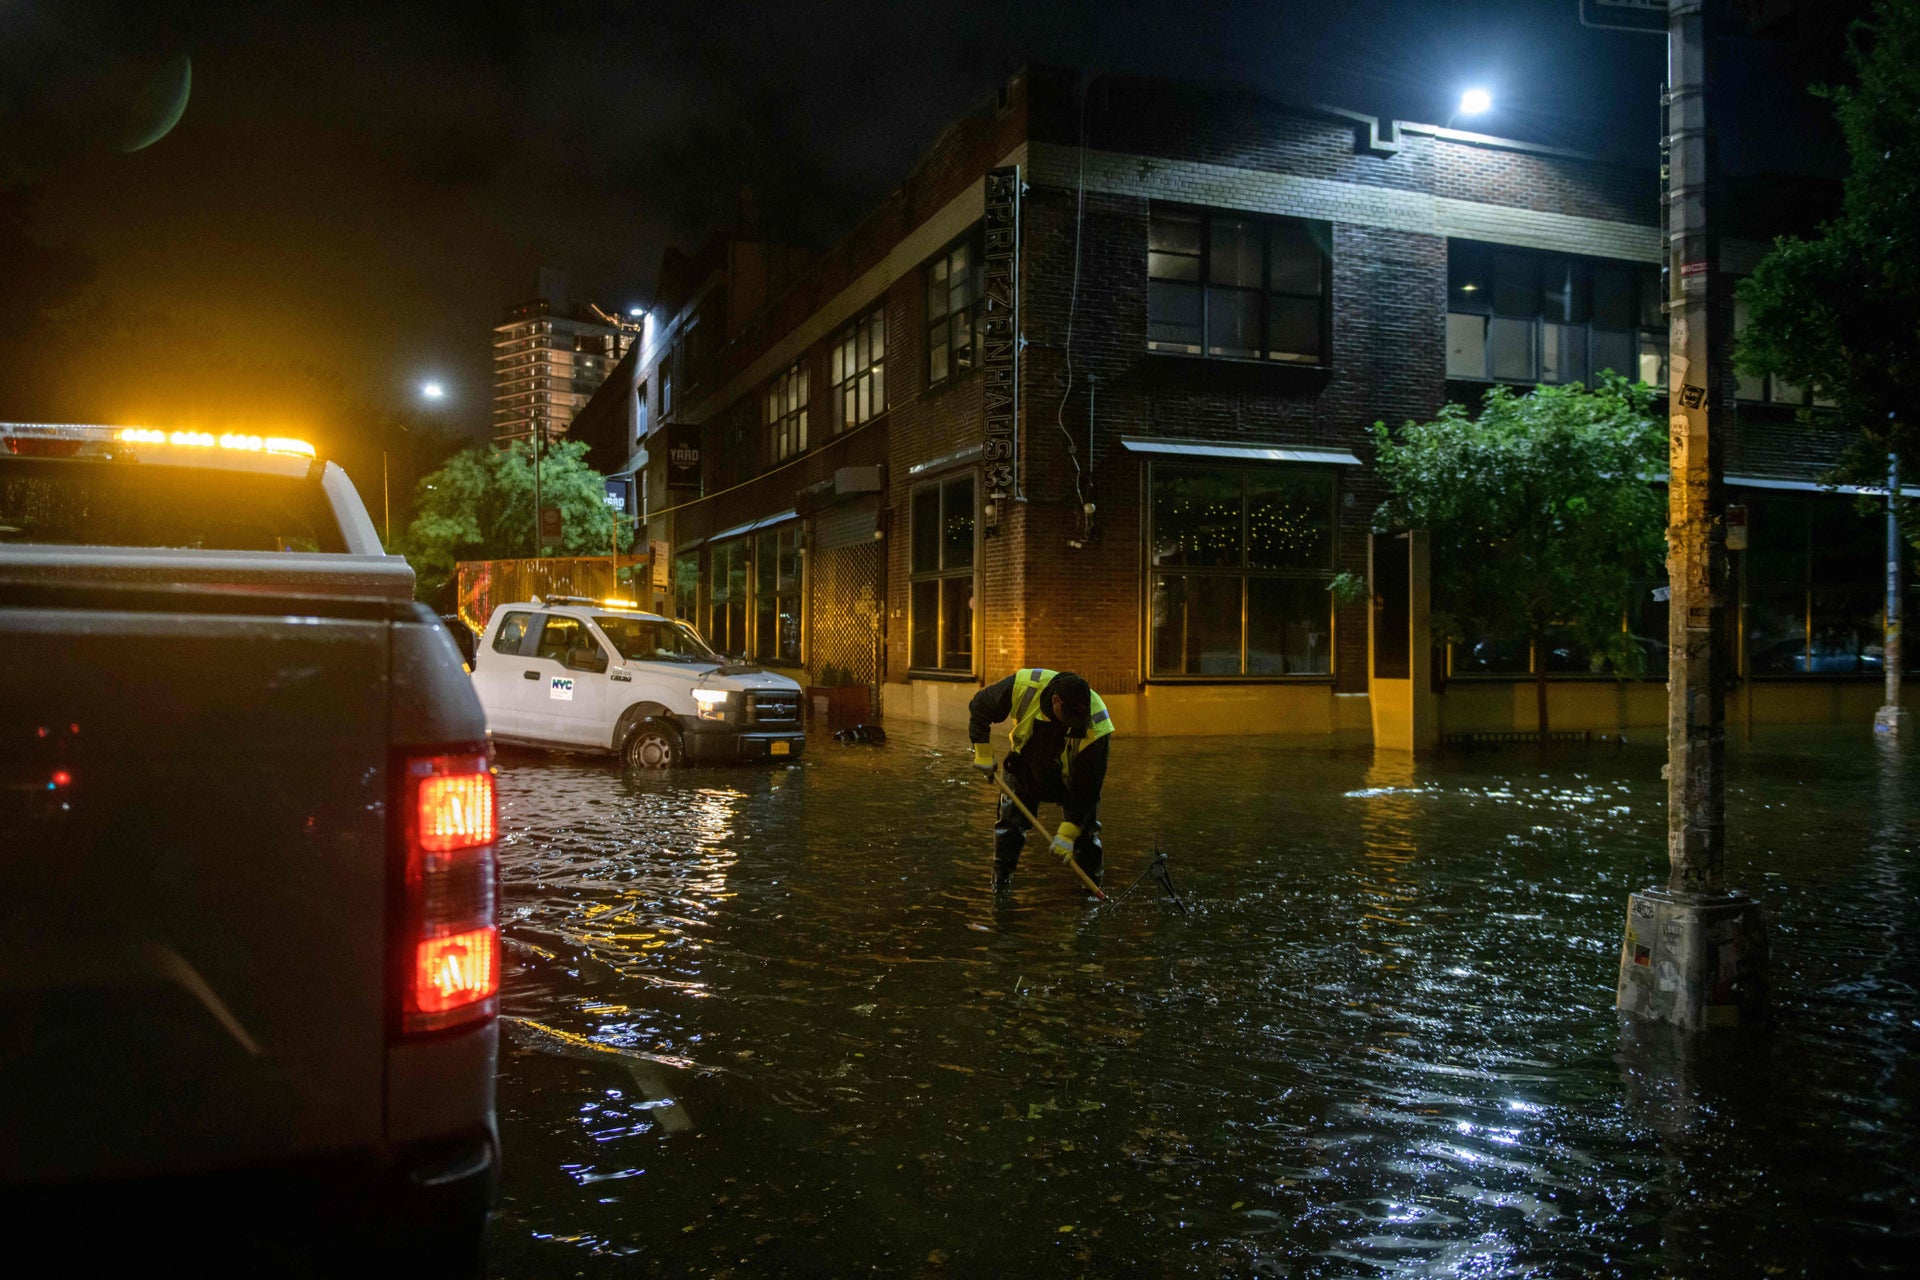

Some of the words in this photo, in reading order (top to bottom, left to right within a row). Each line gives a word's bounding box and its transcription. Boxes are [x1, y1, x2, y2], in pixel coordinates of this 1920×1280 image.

[984, 174, 1014, 461] SPRITZENHAUS
[670, 449, 699, 461] YARD
[984, 465, 1013, 488] 33
[552, 679, 573, 690] NYC
